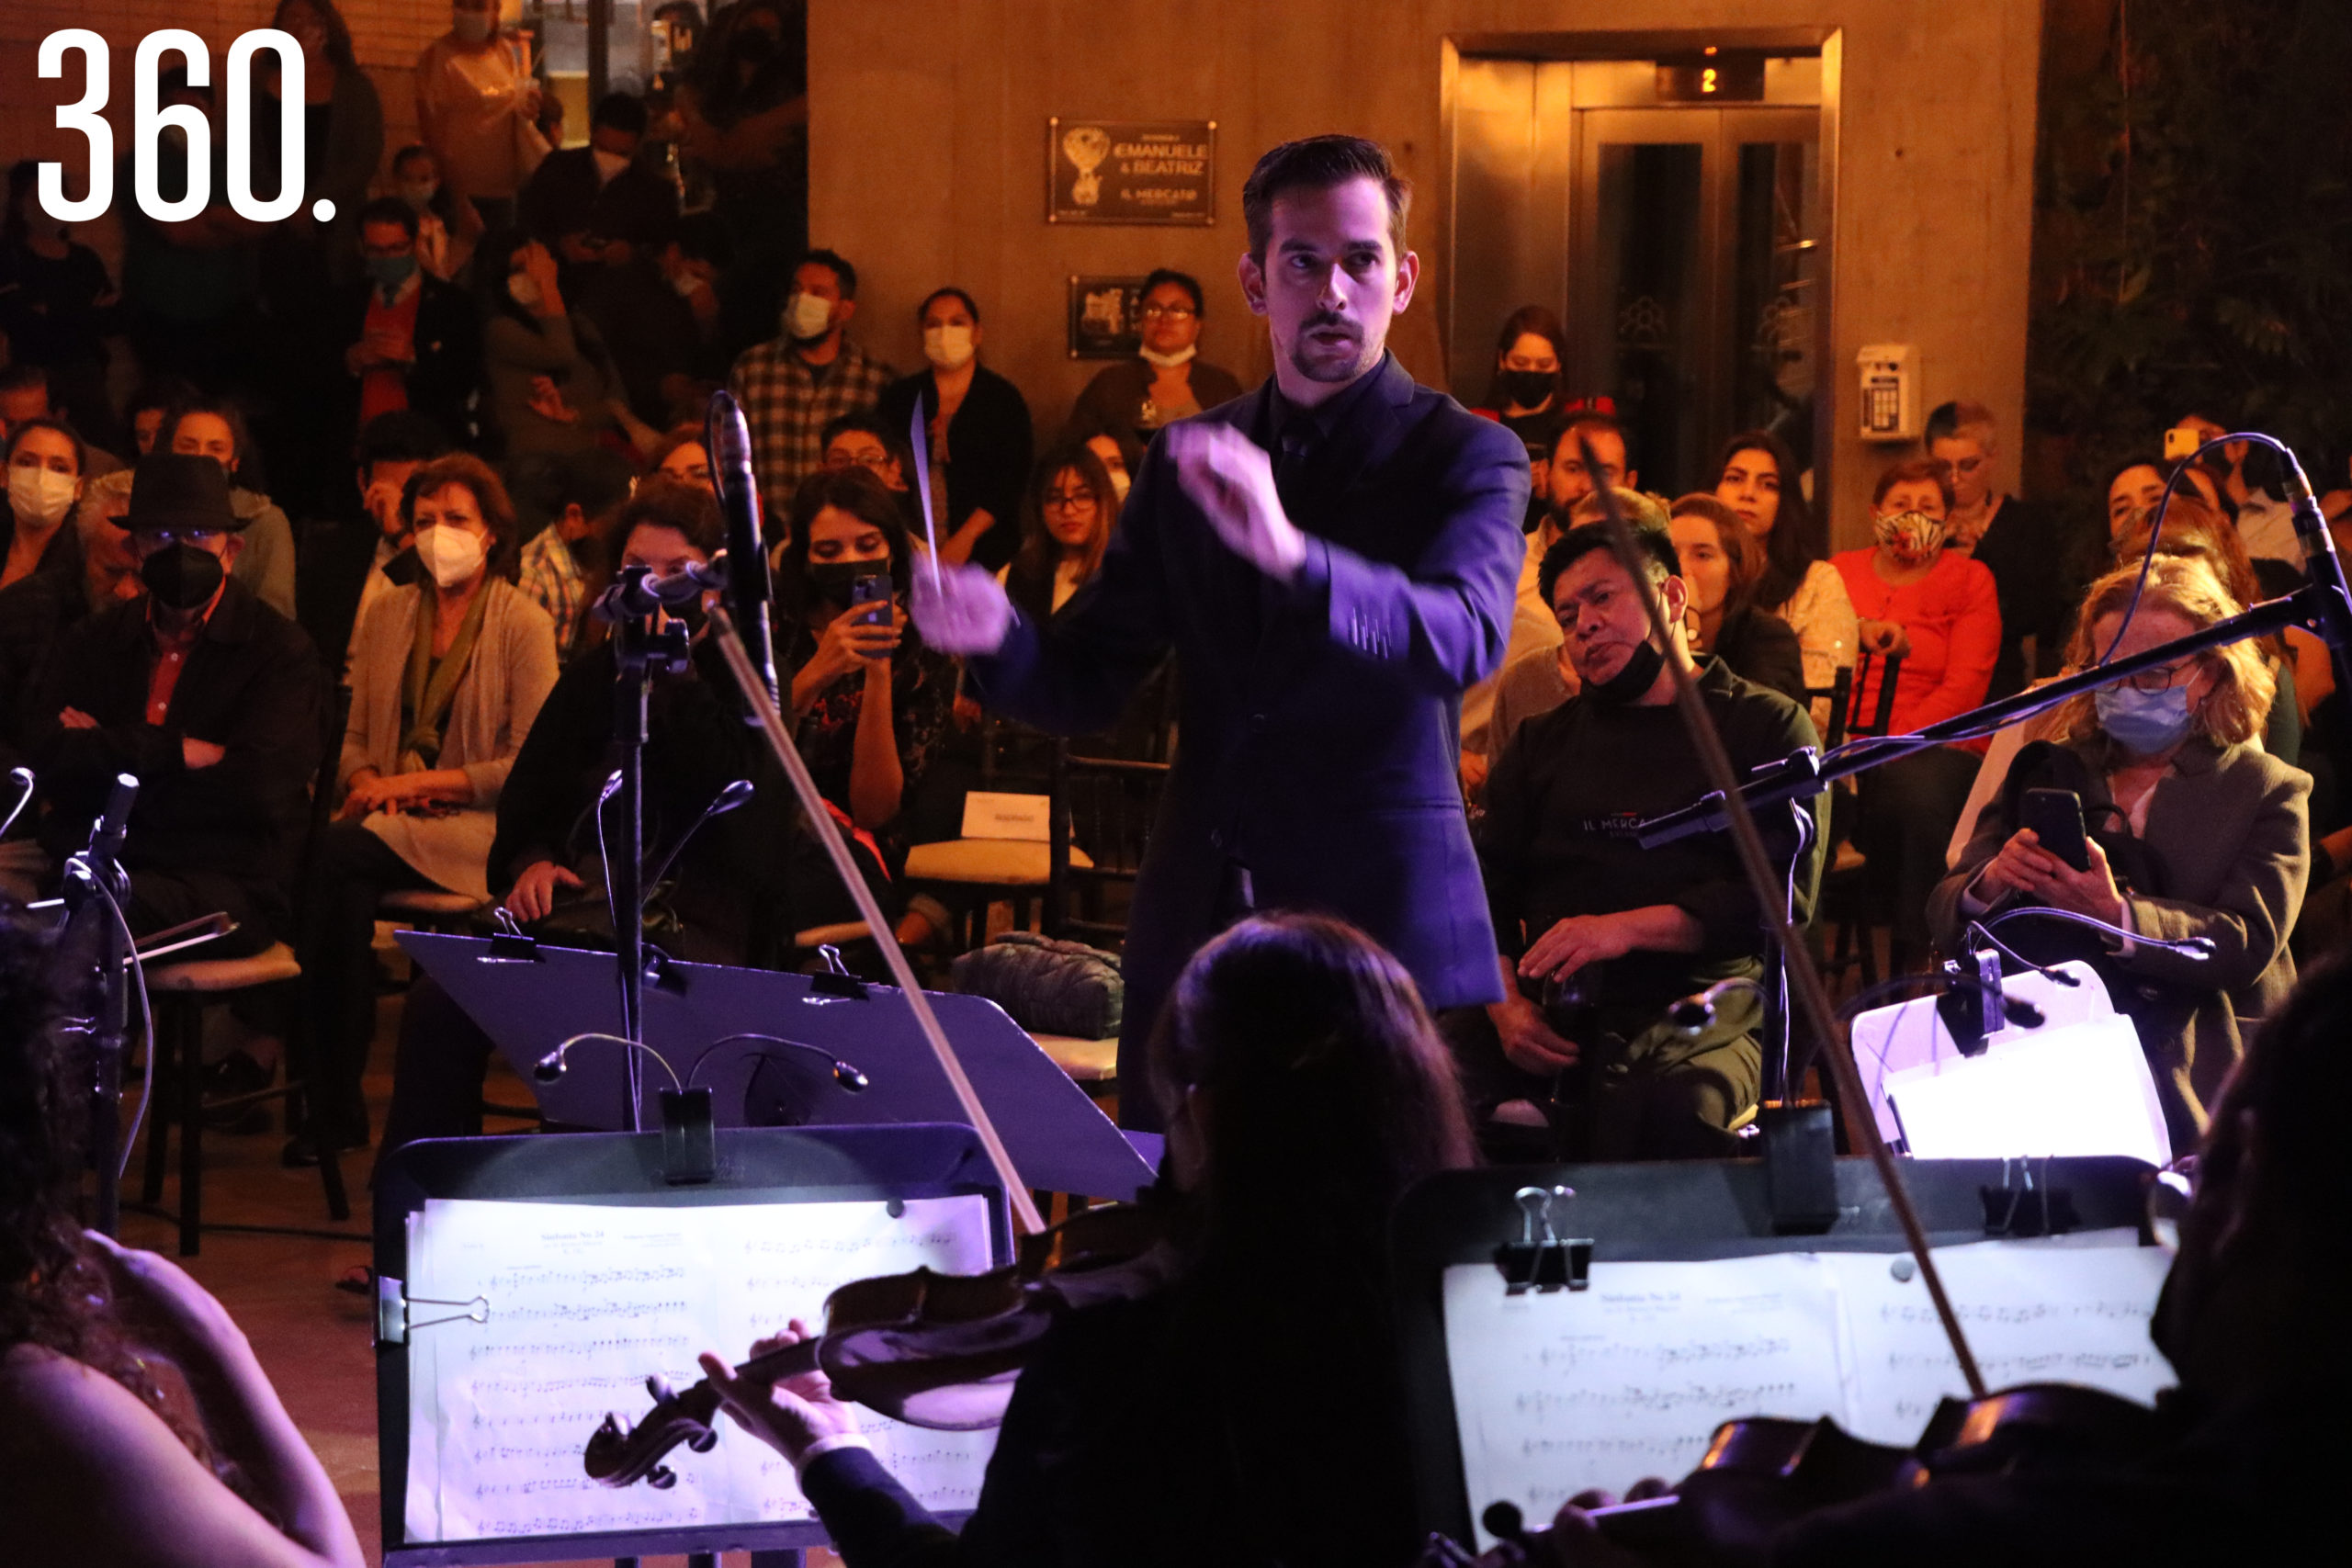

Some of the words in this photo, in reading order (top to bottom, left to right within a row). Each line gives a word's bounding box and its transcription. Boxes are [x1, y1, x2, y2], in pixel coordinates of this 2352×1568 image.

[1702, 68, 1716, 93] 2
[1114, 142, 1208, 158] EMANUELE
[1133, 160, 1204, 175] BEATRIZ
